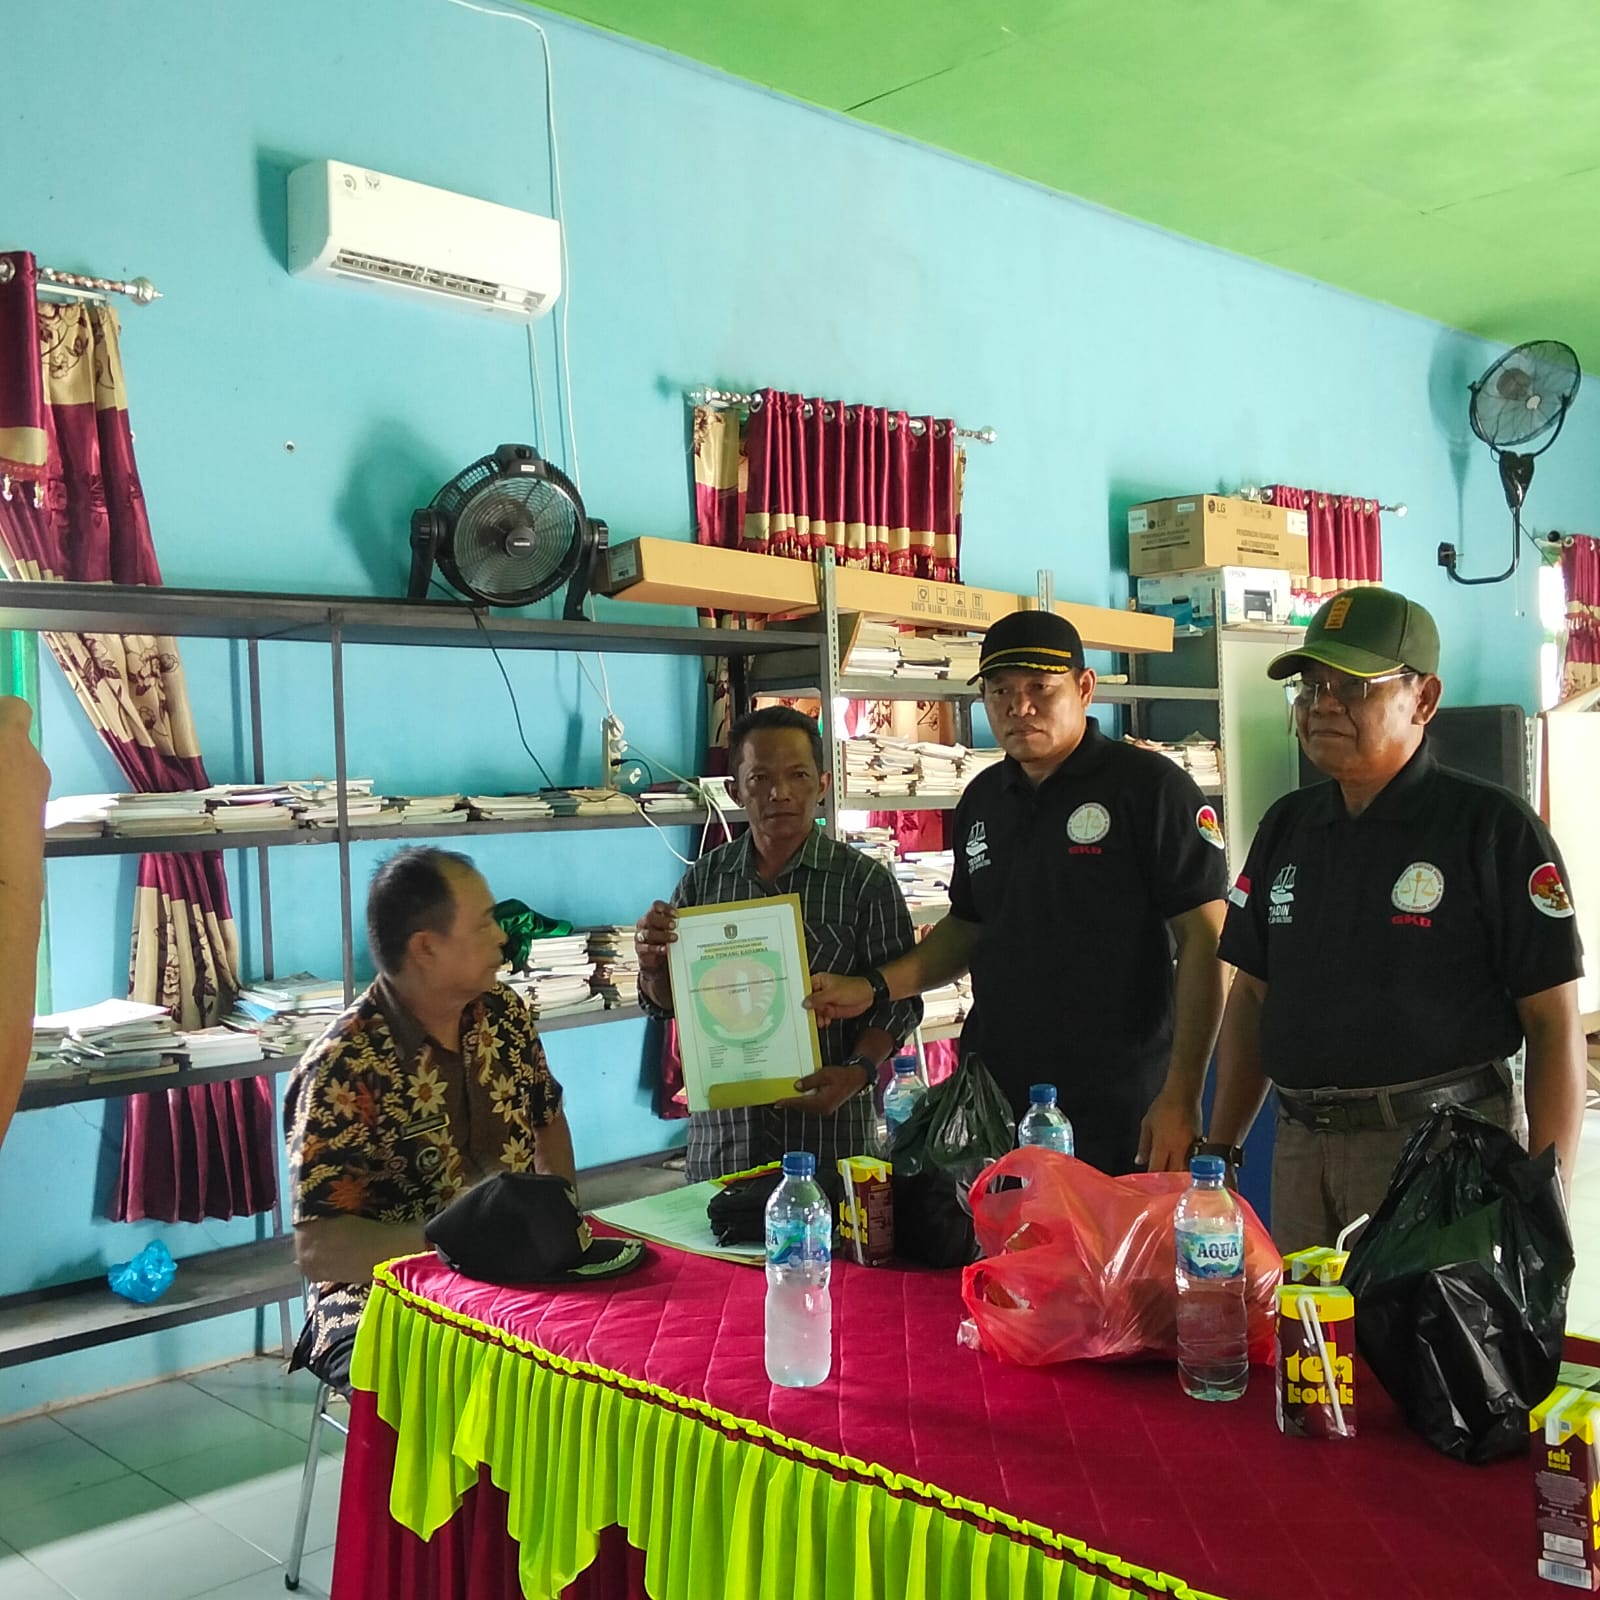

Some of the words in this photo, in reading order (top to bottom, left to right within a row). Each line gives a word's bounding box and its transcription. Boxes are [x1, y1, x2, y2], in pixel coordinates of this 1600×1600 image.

[1216, 503, 1226, 513] LG
[1196, 1242, 1239, 1261] AQUA
[1285, 1341, 1353, 1383] teh
[1547, 1449, 1570, 1465] teh
